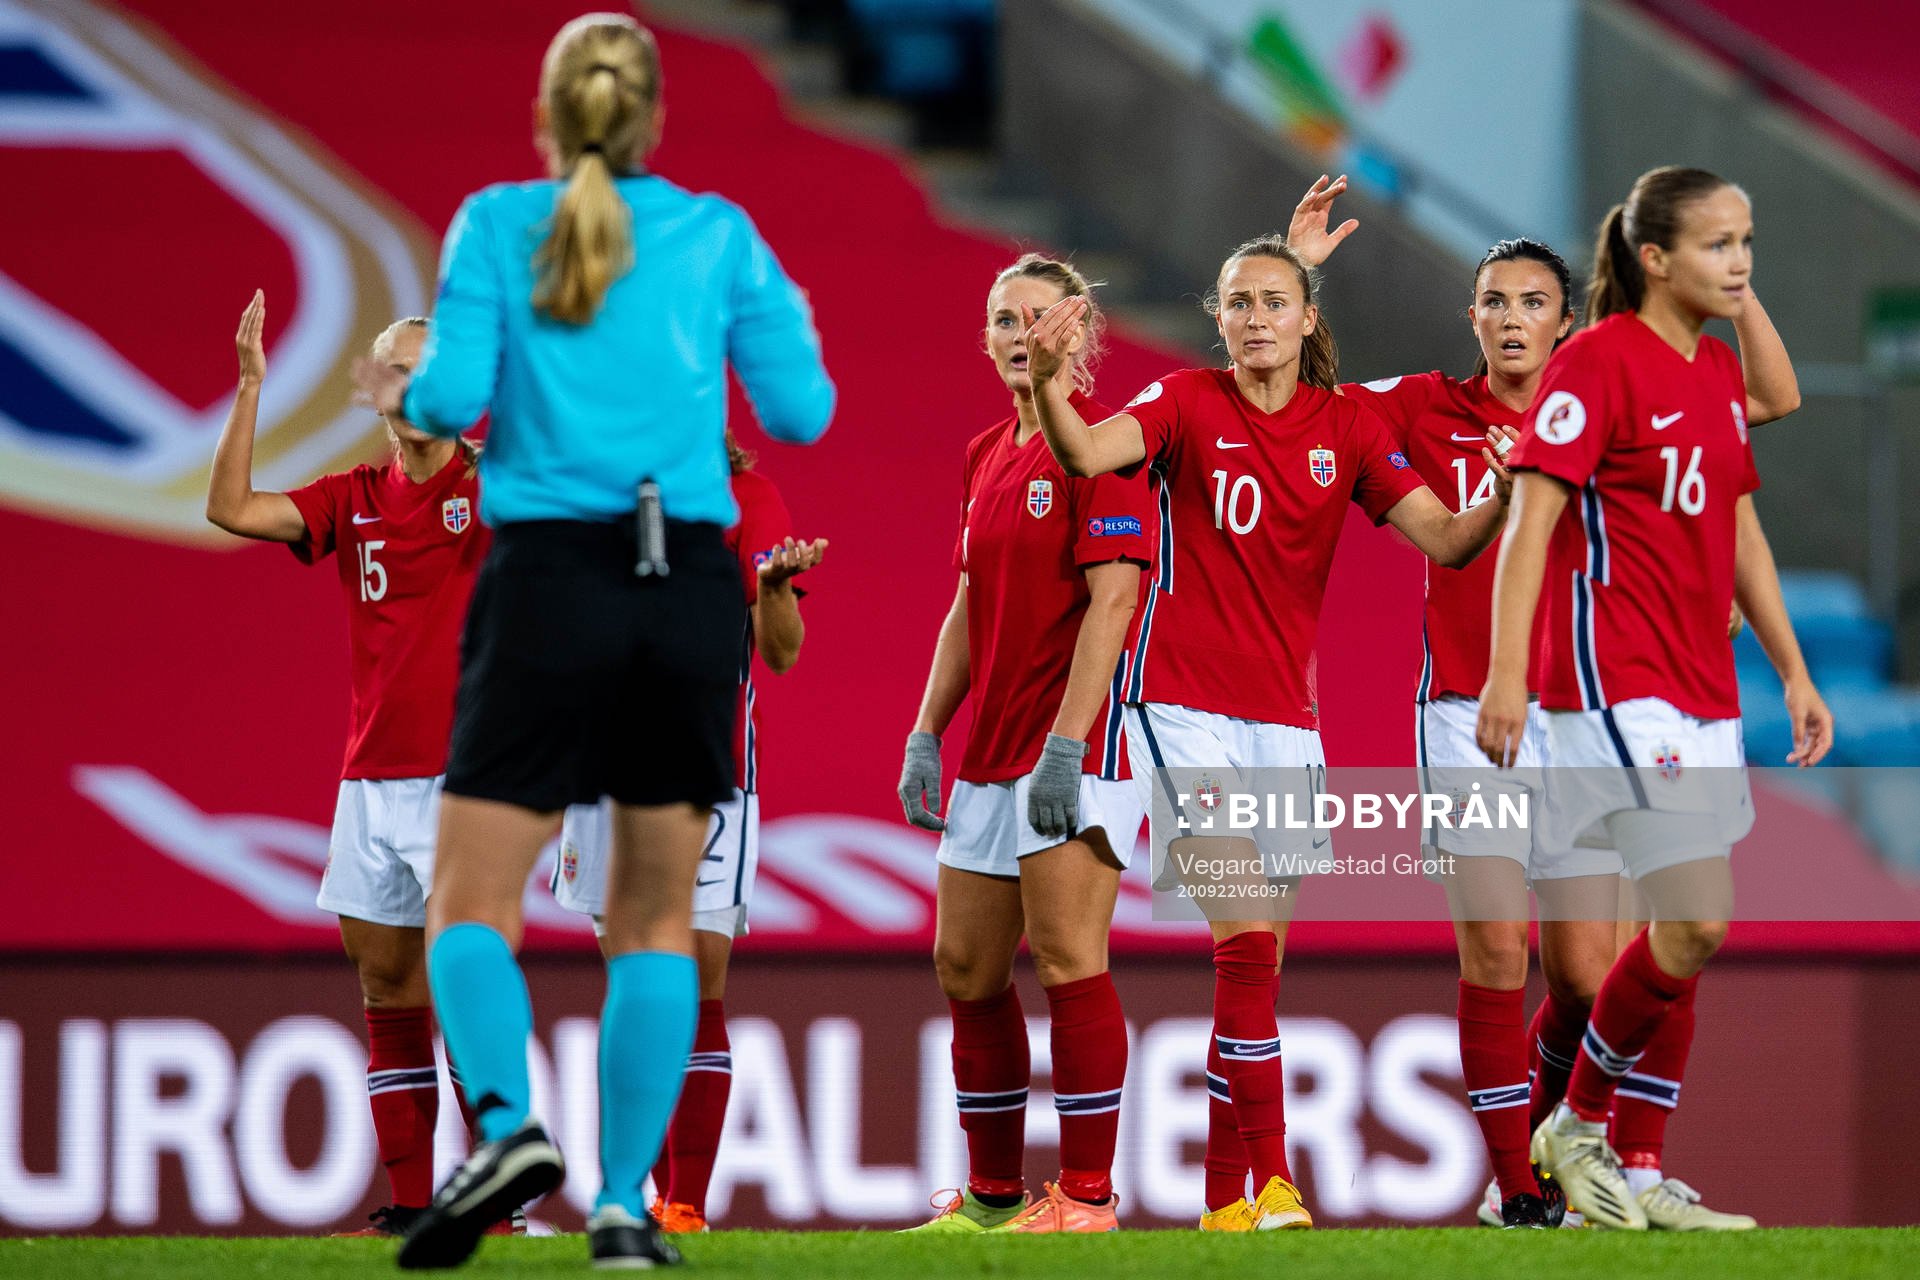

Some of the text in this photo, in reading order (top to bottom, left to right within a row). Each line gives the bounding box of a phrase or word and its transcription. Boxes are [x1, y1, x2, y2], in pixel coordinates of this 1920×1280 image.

[1212, 470, 1262, 535] 10
[1451, 458, 1496, 517] 14
[1660, 446, 1706, 516] 16
[1105, 521, 1141, 531] RESPECT
[357, 540, 388, 602] 15
